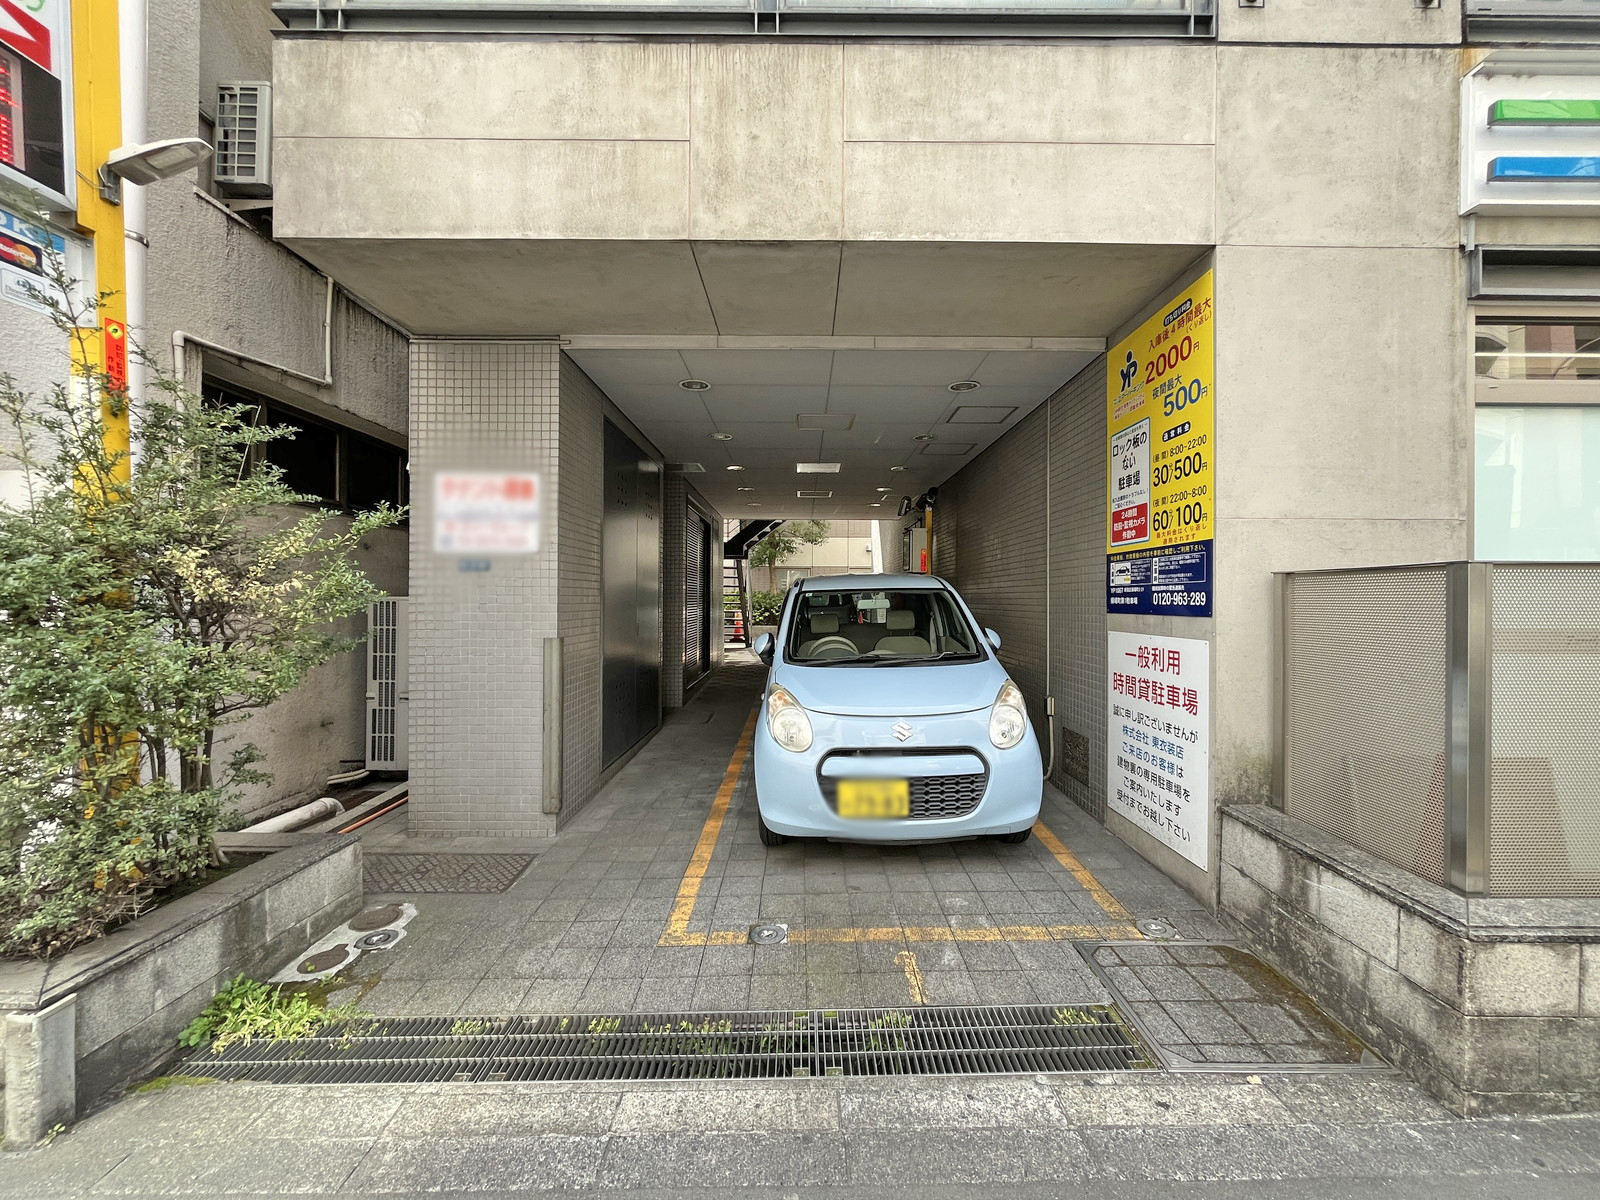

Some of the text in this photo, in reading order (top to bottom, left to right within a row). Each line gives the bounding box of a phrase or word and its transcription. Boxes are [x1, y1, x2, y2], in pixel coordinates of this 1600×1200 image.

[1145, 335, 1200, 385] 2000円
[1152, 374, 1182, 399] 夜間最大
[1163, 378, 1208, 417] 500円
[1112, 431, 1147, 458] ロック板の
[1122, 455, 1136, 470] ない
[1118, 470, 1141, 491] 駐車場
[1153, 592, 1206, 606] 0120-963-289
[1125, 645, 1181, 676] 一般利用
[1113, 672, 1199, 716] 時間貸駐車場
[1113, 703, 1199, 744] 誠に申し訳ございませんが
[1122, 724, 1149, 746] 株式会社
[1117, 755, 1190, 803] 建物裏の専用駐車場を
[1122, 741, 1184, 779] ご来店のお客様は
[1116, 789, 1191, 842] 受付までお越し下さい
[1123, 776, 1182, 817] ご案内いたします
